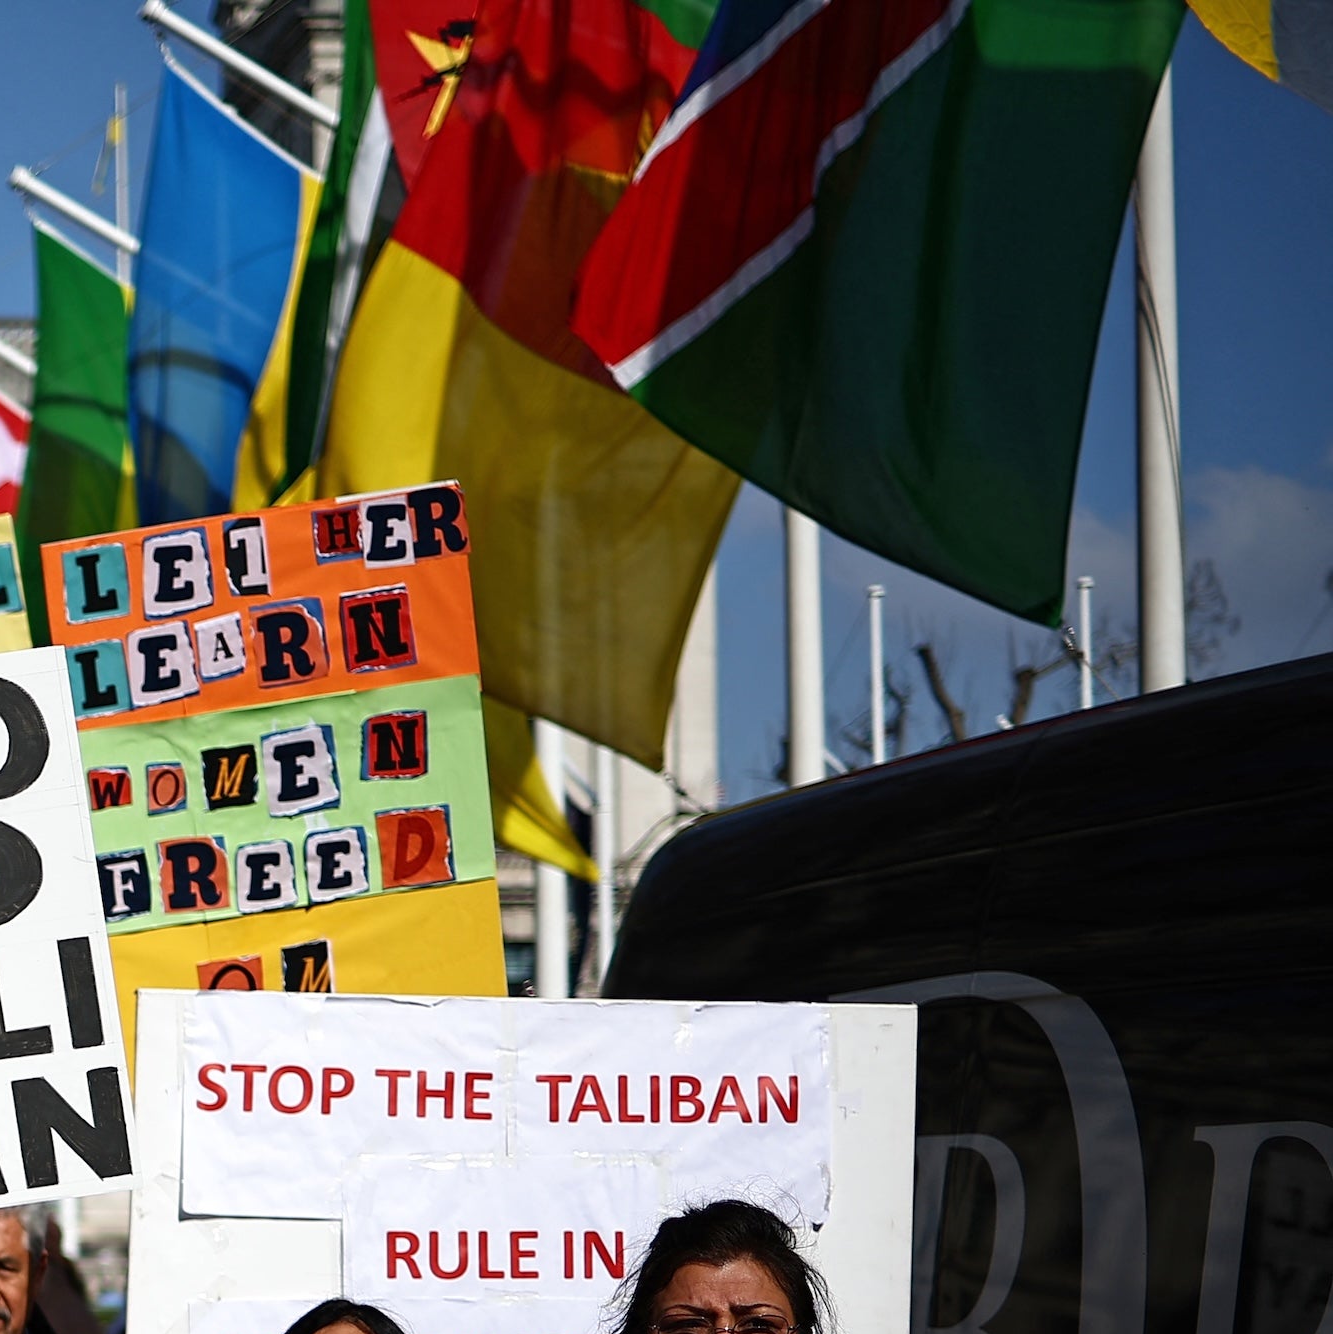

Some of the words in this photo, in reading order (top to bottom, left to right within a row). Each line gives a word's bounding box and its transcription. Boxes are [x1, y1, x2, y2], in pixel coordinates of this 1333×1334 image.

[75, 525, 267, 613] LET
[320, 487, 468, 561] HER
[75, 598, 408, 709] LEARN
[92, 720, 417, 808] WOMEN
[104, 813, 433, 913] FREED
[196, 1063, 354, 1115] STOP
[375, 1068, 493, 1121] THE
[536, 1074, 800, 1124] TALIBAN
[387, 1230, 538, 1280] RULE
[564, 1230, 625, 1280] IN
